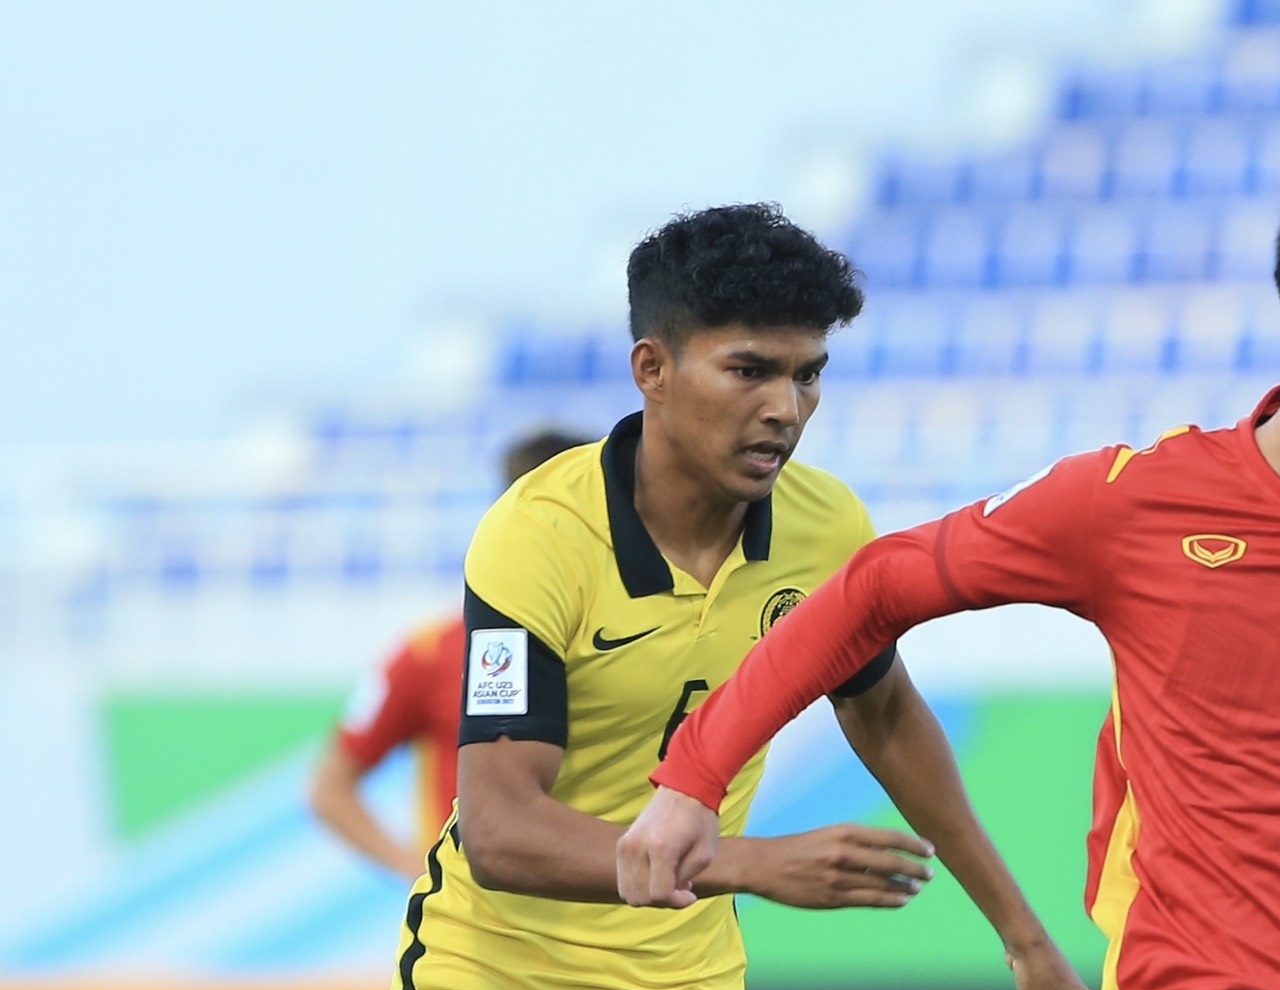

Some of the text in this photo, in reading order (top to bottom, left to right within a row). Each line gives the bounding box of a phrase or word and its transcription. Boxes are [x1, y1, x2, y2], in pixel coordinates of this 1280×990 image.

[477, 681, 494, 690] AFC
[473, 689, 519, 698] ASIAN CUP
